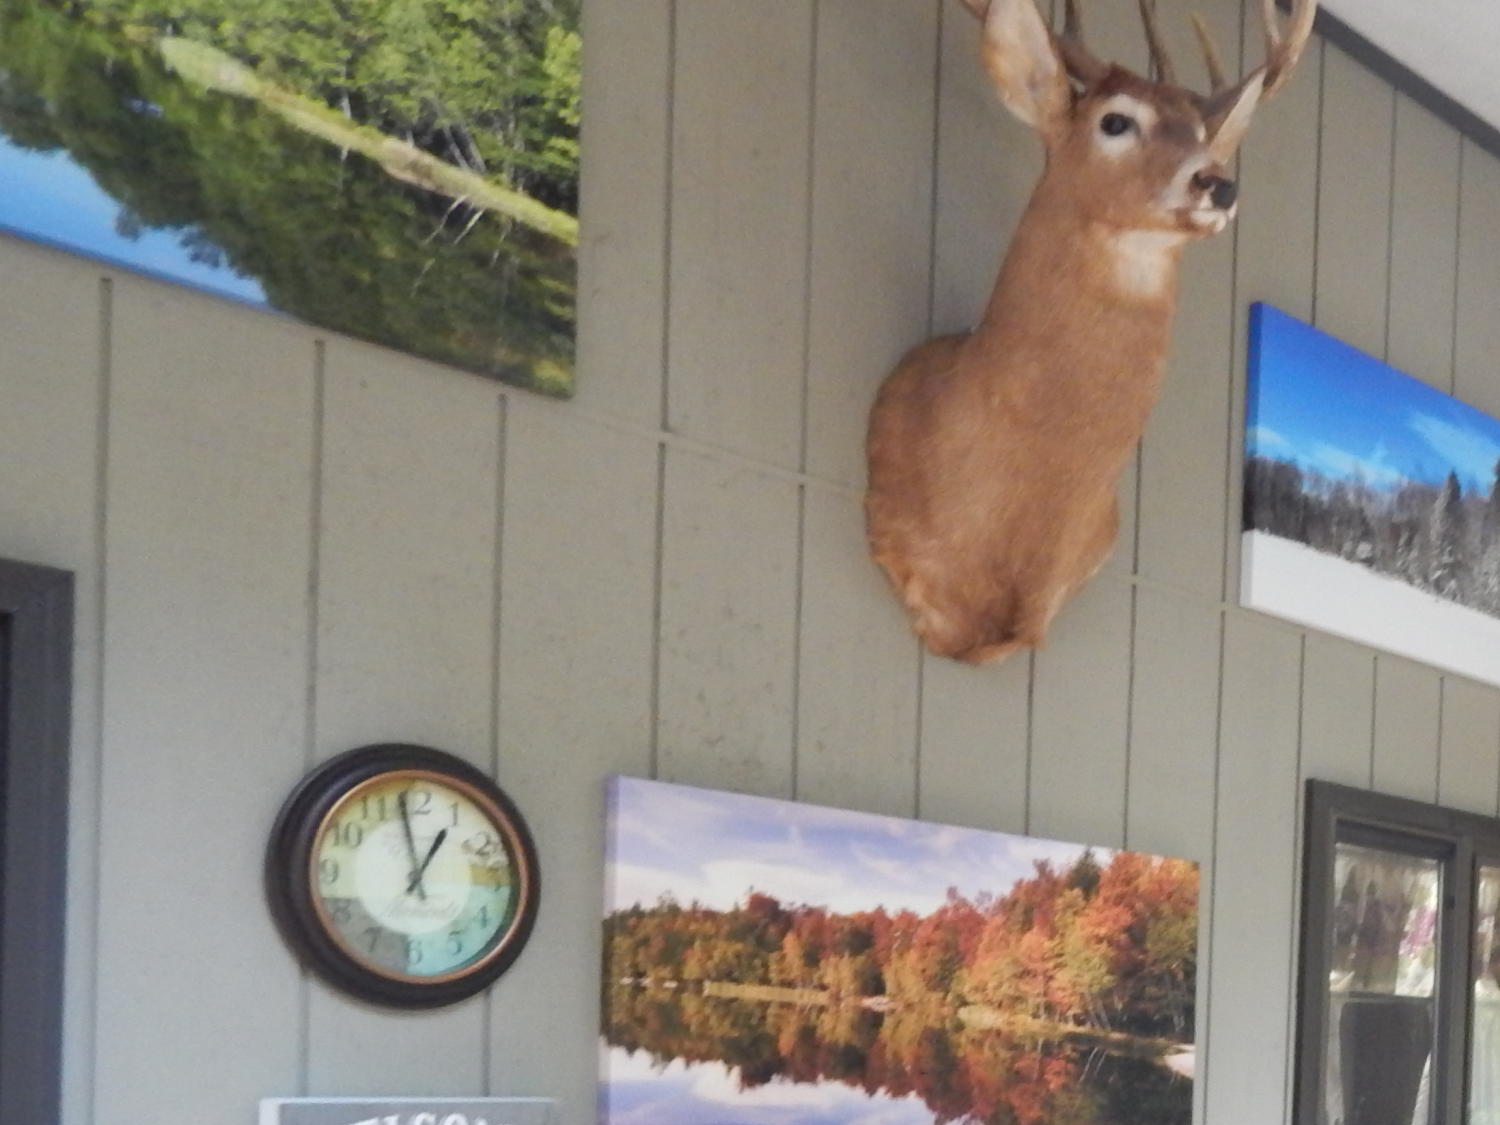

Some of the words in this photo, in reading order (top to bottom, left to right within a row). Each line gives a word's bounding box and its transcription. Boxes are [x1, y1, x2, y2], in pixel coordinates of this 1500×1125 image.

[361, 796, 387, 821] 11
[449, 802, 460, 828] 1
[333, 822, 363, 849] 10
